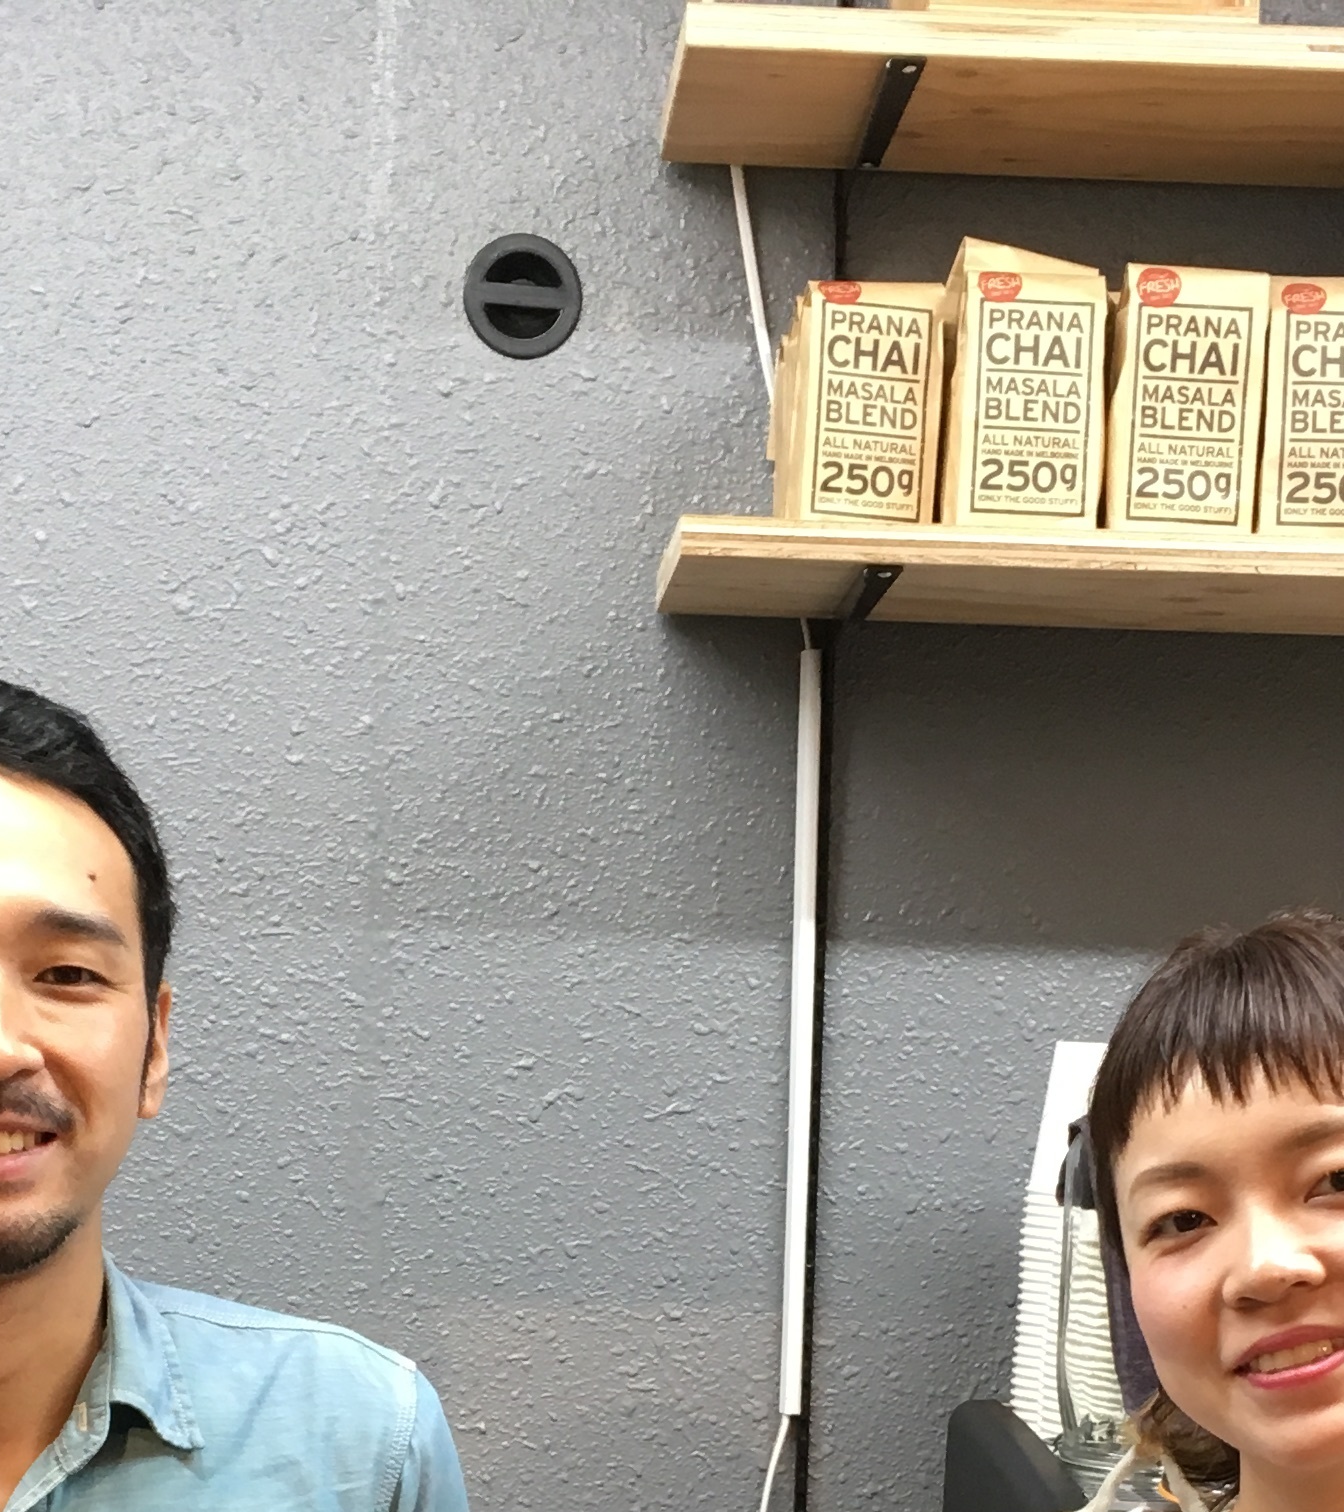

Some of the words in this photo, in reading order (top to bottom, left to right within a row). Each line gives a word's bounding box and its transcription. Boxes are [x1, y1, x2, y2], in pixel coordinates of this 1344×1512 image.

[980, 276, 1021, 290] FRESH
[1139, 277, 1180, 295] FRESH
[830, 310, 923, 338] PRANA
[989, 308, 1084, 333] PRANA
[1146, 313, 1242, 339] PRANA
[827, 334, 920, 375] CHAI
[986, 332, 1082, 369] CHAI
[1143, 338, 1239, 376] CHAI
[827, 379, 918, 406] MASALA
[986, 376, 1081, 399] MASALA
[1142, 384, 1236, 408] MASALA
[825, 400, 917, 431] BLEND
[984, 398, 1080, 424] BLEND
[1140, 405, 1235, 433] BLEND
[822, 436, 848, 449] ALL
[853, 439, 916, 456] NATURAL
[982, 433, 1009, 446] ALL
[1013, 435, 1080, 450] NATURAL
[1137, 442, 1163, 455] ALL
[1168, 444, 1234, 459] NATURAL
[1288, 447, 1315, 459] ALL
[820, 461, 914, 497] 250g
[979, 458, 1077, 493] 250g
[1135, 466, 1232, 501] 250g
[844, 498, 860, 506] THE
[861, 499, 883, 509] GOOD
[1004, 495, 1021, 503] THE
[1022, 496, 1046, 504] GOOD
[1160, 503, 1177, 512] THE
[1178, 504, 1201, 513] GOOD
[1310, 508, 1327, 516] THE
